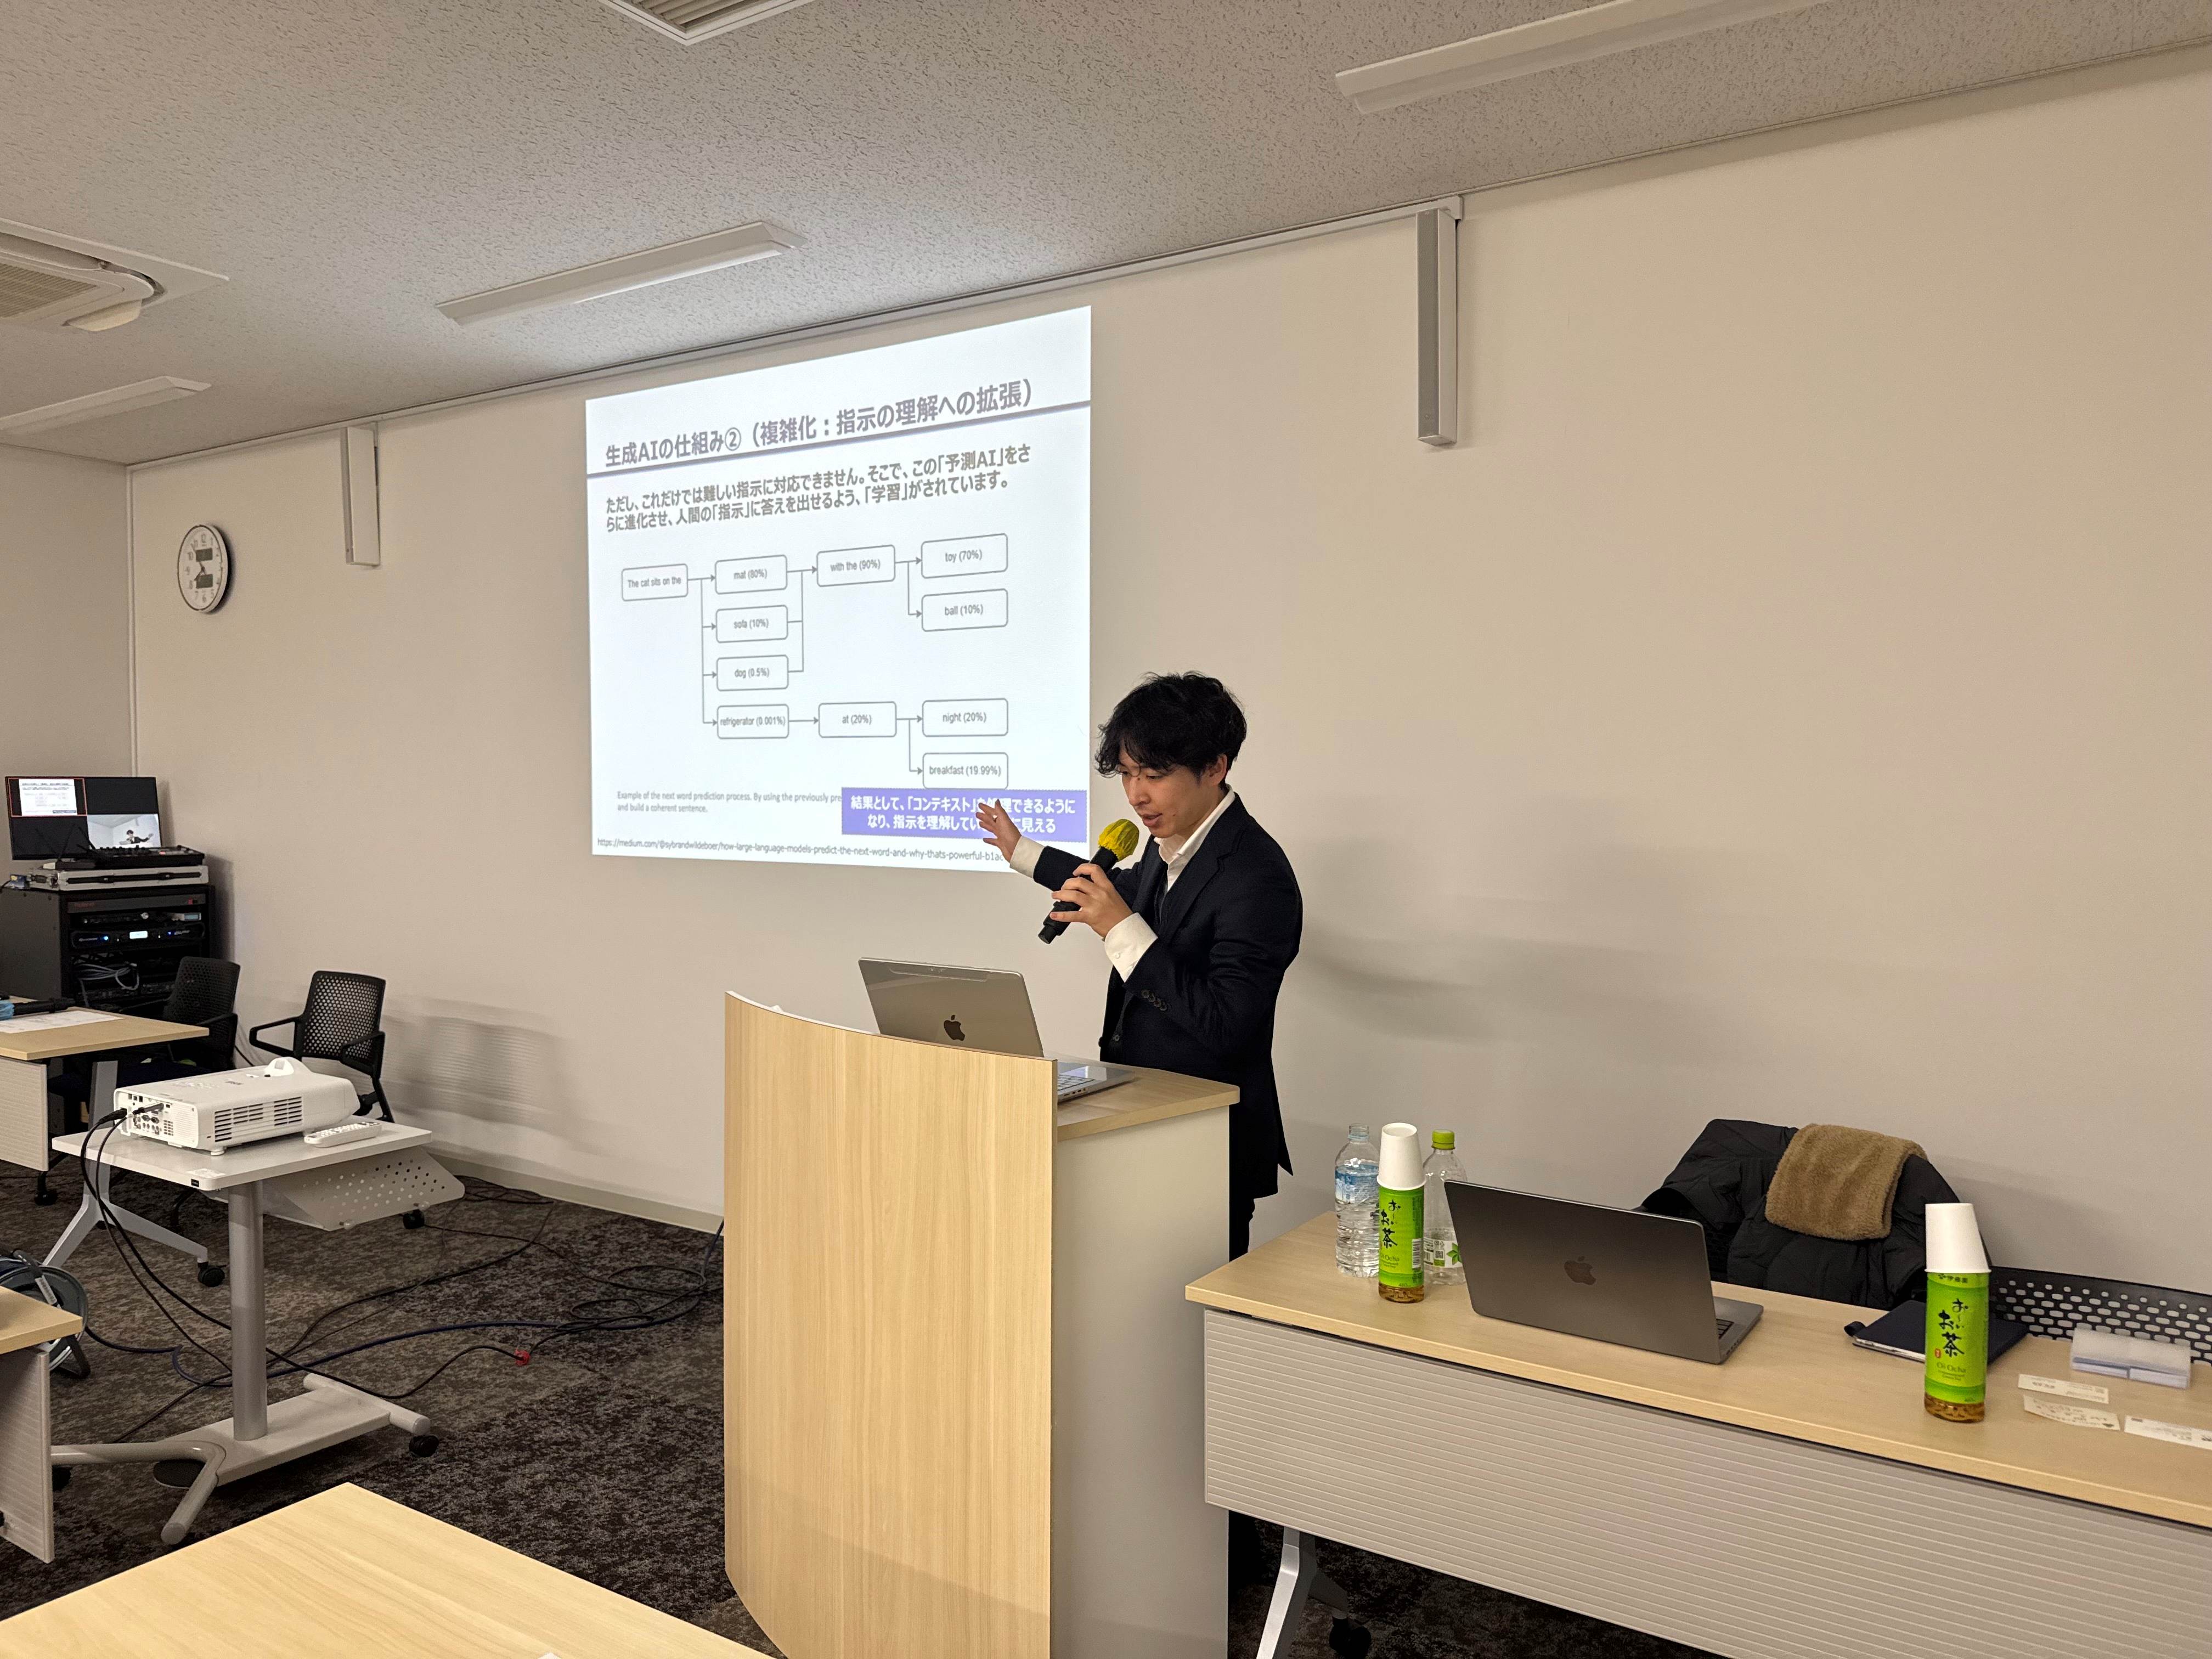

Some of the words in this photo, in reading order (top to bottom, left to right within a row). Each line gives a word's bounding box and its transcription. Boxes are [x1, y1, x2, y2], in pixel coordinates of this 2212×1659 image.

[945, 552, 957, 563] toy
[959, 549, 983, 562] (70%)
[830, 561, 844, 572] with
[847, 561, 857, 571] the
[859, 559, 881, 571] (90%)
[733, 571, 746, 580] mat
[748, 569, 767, 580] (80%)
[628, 579, 639, 588] The
[641, 578, 650, 587] cat
[651, 577, 661, 586] sits
[672, 576, 681, 585] the
[945, 606, 958, 616] ball
[960, 604, 984, 616] (10%)
[733, 620, 748, 629] sofa
[749, 618, 769, 629] (10%)
[735, 668, 747, 679] dog
[748, 668, 770, 678] (0.5%)
[720, 716, 754, 727] refrigerator
[756, 716, 786, 727] (0.001%)
[851, 715, 872, 725] (20%)
[943, 712, 961, 724] night
[963, 712, 986, 723] (20%)
[929, 766, 964, 775] breakfast
[966, 765, 1001, 777] (19.99%)
[617, 791, 642, 800] Example
[643, 791, 649, 799] of
[676, 792, 692, 800] word
[693, 792, 724, 801] prediction
[726, 793, 752, 802] process.
[754, 793, 761, 802] By
[763, 792, 780, 803] using
[782, 792, 793, 801] the
[795, 793, 828, 803] previously
[630, 803, 644, 811] build
[651, 804, 677, 812] coherent
[868, 814, 1056, 833] なり、指示を理解していに見える
